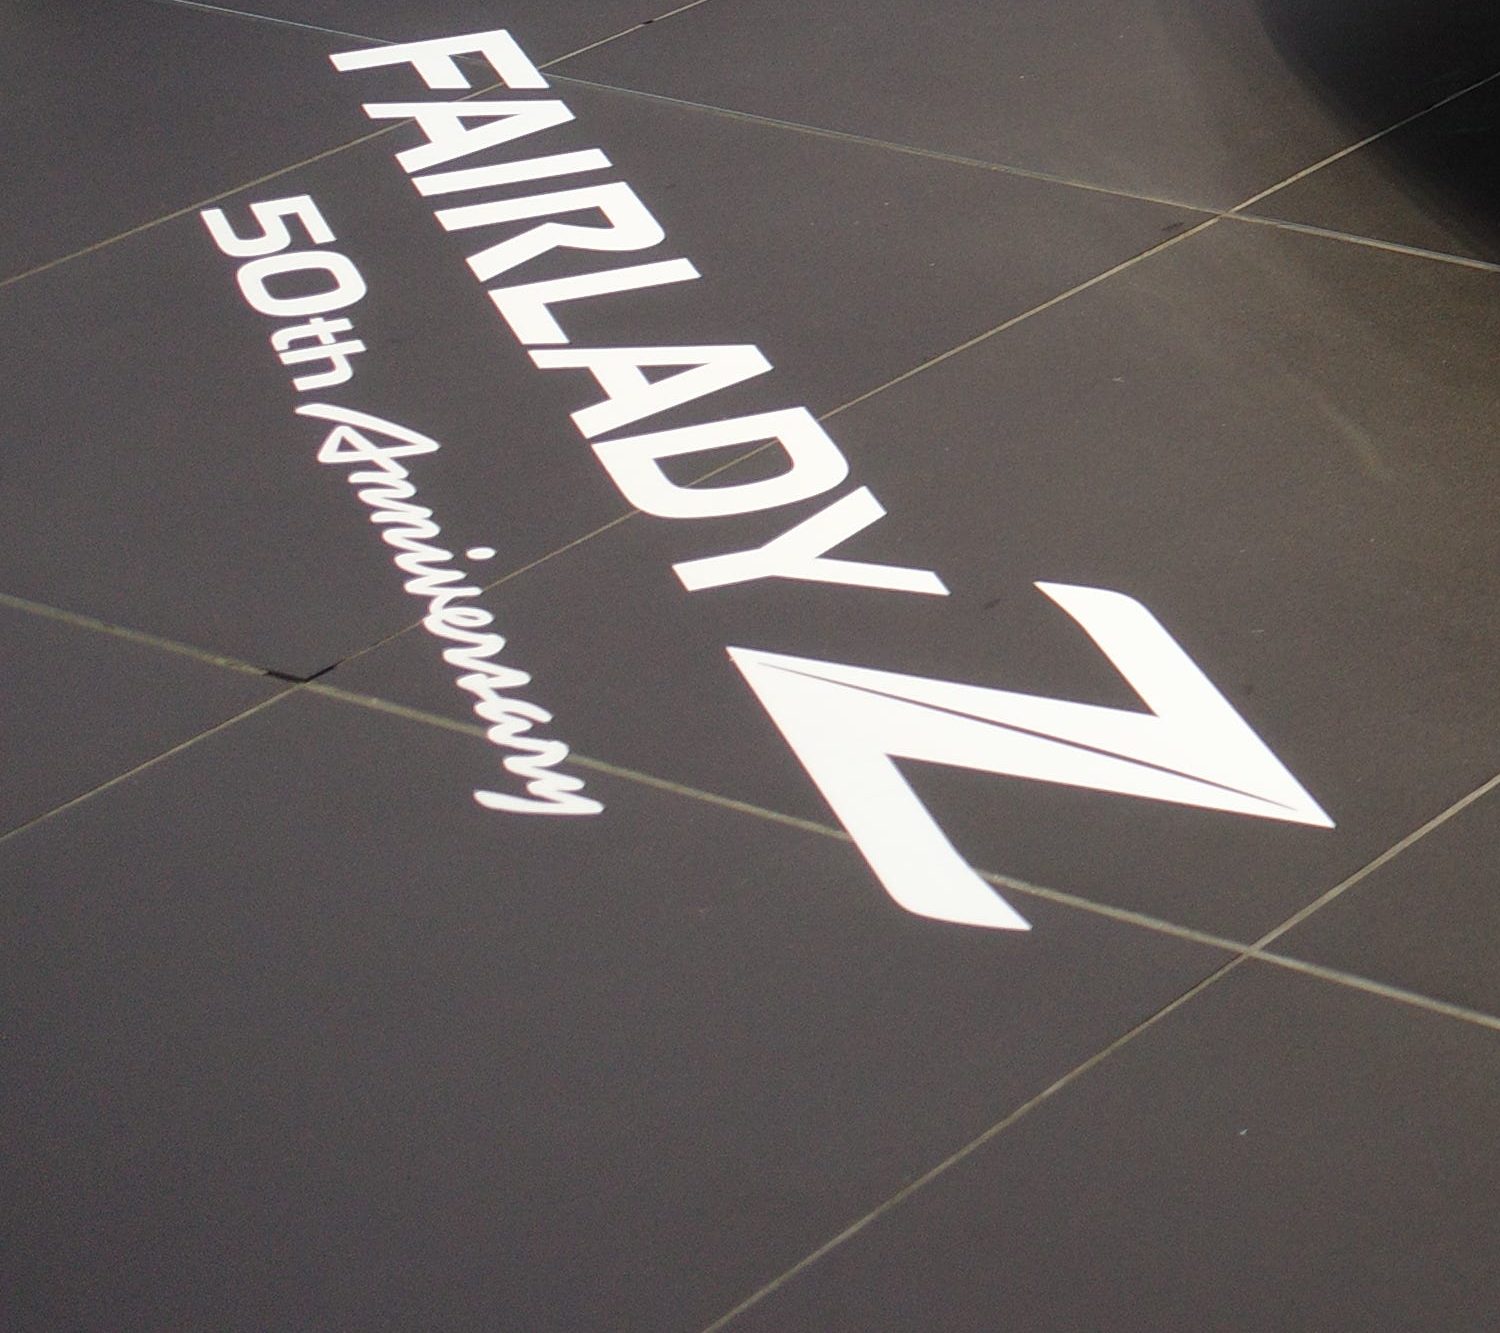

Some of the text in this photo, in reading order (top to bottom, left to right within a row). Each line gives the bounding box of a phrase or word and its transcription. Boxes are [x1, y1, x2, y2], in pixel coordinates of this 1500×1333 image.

[200, 194, 605, 815] 50th Anniversary
[330, 30, 1335, 931] FAIRLADY Z
